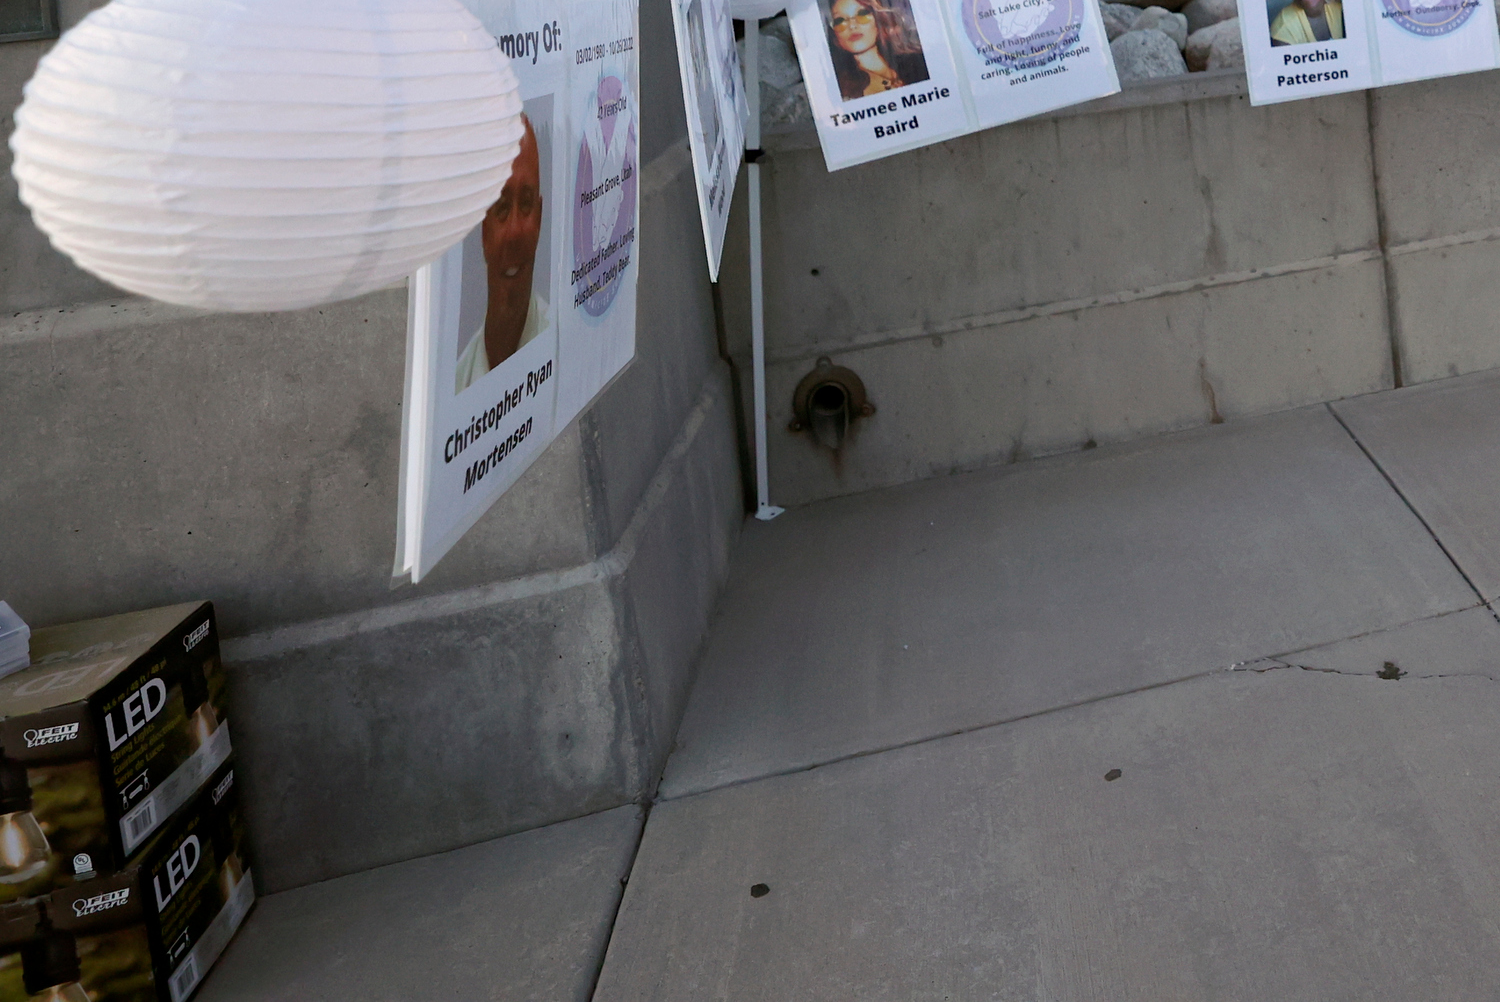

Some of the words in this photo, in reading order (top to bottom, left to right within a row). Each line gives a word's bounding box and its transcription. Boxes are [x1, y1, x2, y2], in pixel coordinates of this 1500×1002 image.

[978, 9, 996, 20] Salt
[999, 4, 1020, 14] Lake
[1060, 23, 1081, 33] Love
[1060, 46, 1090, 60] people
[1284, 49, 1338, 66] Porchia
[1030, 66, 1068, 80] animals.
[1278, 69, 1348, 86] Patterson
[831, 99, 897, 127] Tawnee
[901, 86, 950, 109] Marie
[874, 117, 919, 139] Baird
[580, 185, 603, 208] Pleasant
[605, 173, 620, 193] Grove,
[571, 250, 600, 285] Dedicated
[620, 227, 635, 248] Loving
[445, 382, 524, 464] Christopher
[526, 359, 552, 398] Ryan
[464, 417, 532, 494] Mortensen
[105, 678, 166, 751] LED
[39, 723, 78, 738] FEIT
[111, 742, 132, 763] String
[134, 723, 154, 744] Lights
[154, 835, 199, 913] LED
[88, 889, 129, 906] FEIT
